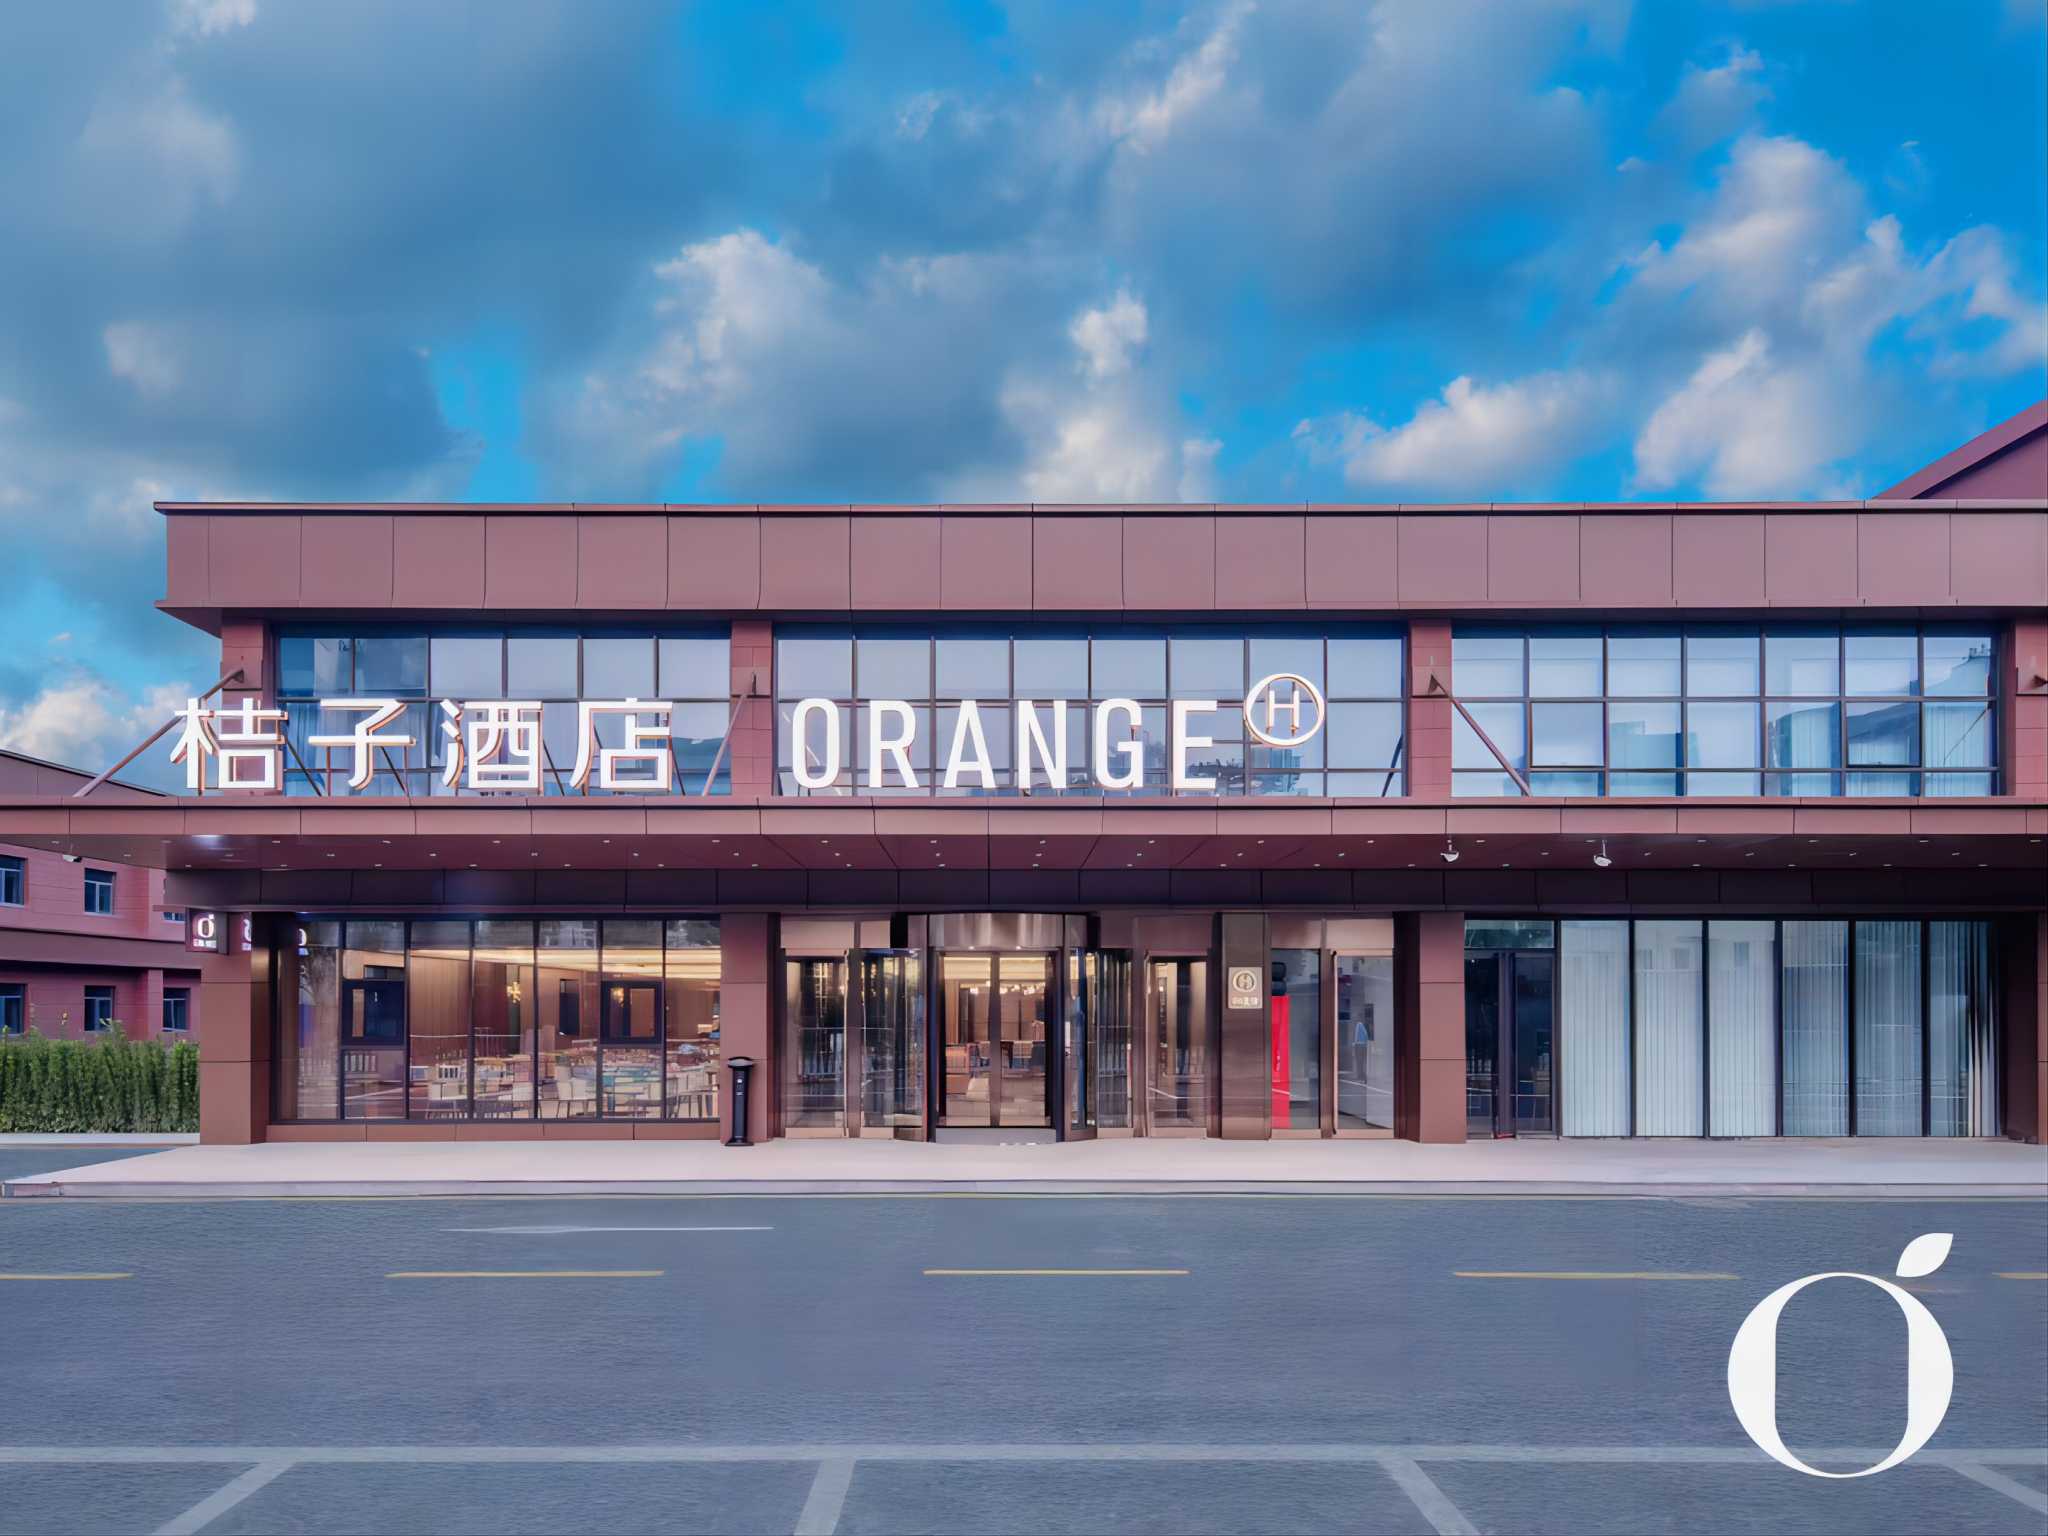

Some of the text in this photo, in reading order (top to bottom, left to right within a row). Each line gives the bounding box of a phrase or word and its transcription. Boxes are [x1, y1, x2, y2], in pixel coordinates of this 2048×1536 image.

[170, 697, 674, 790] 桔子酒店
[792, 698, 1218, 790] ORANGE
